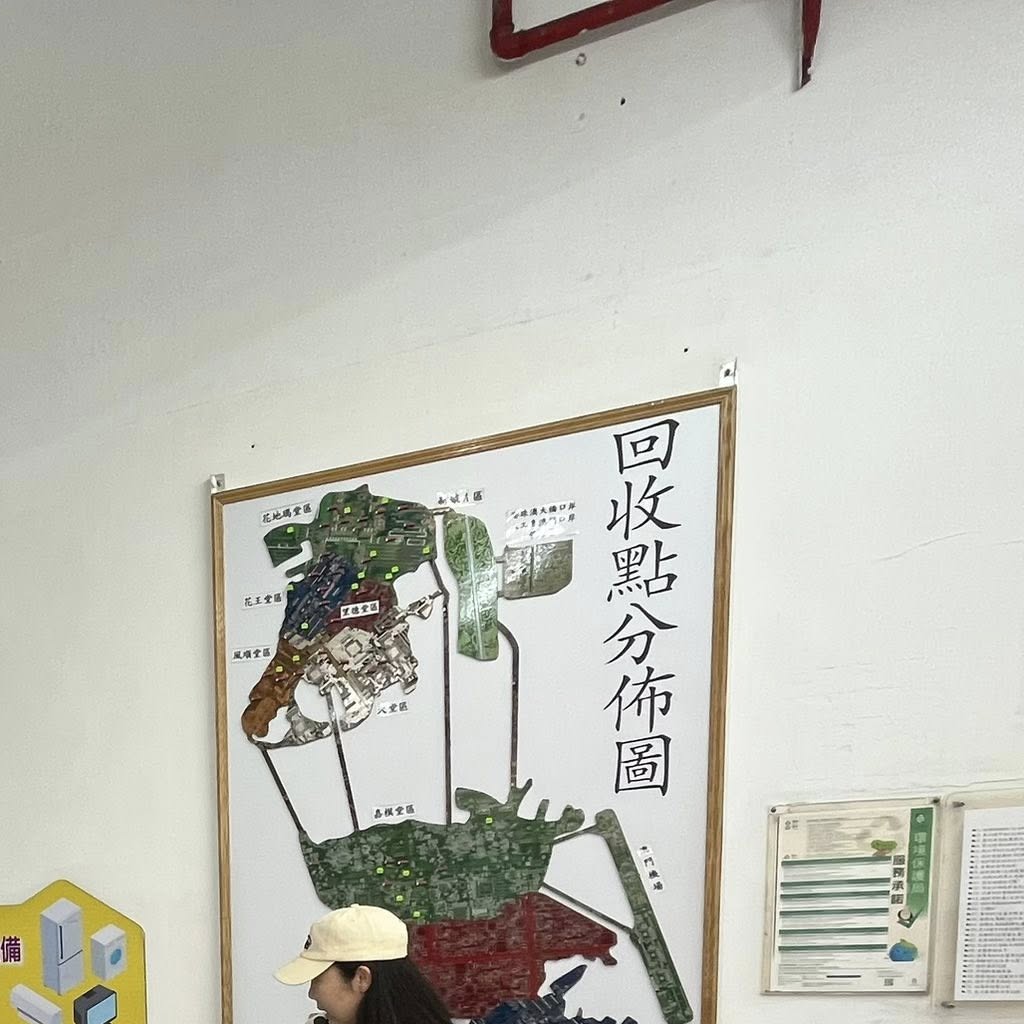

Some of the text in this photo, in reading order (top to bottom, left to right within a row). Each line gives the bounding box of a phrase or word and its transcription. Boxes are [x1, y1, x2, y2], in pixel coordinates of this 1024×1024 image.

[262, 503, 312, 523] 花地瑪堂區
[244, 593, 282, 606] 花王堂區
[603, 419, 681, 796] 回收點分佈圖
[232, 647, 271, 660] 風順堂區
